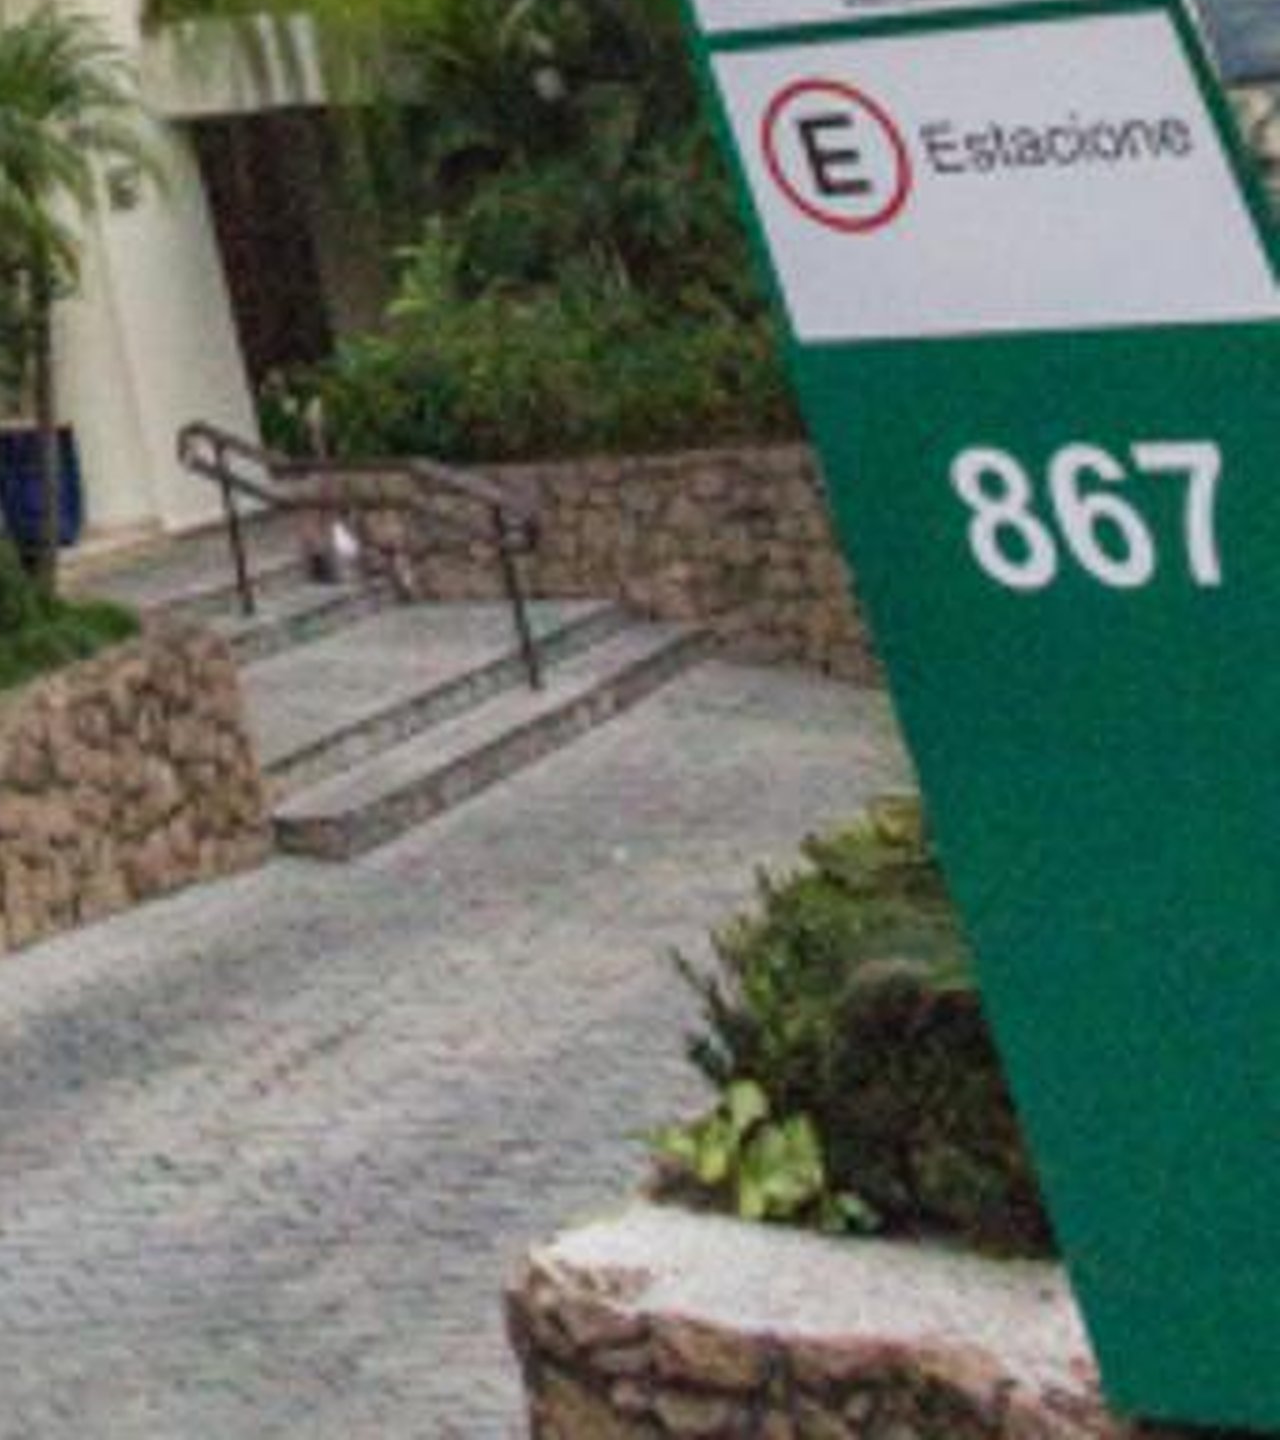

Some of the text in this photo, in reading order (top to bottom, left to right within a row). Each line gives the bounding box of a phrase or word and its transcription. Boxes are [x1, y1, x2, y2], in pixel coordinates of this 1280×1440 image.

[795, 111, 1194, 197] E Estacione
[948, 439, 1222, 590] 867
